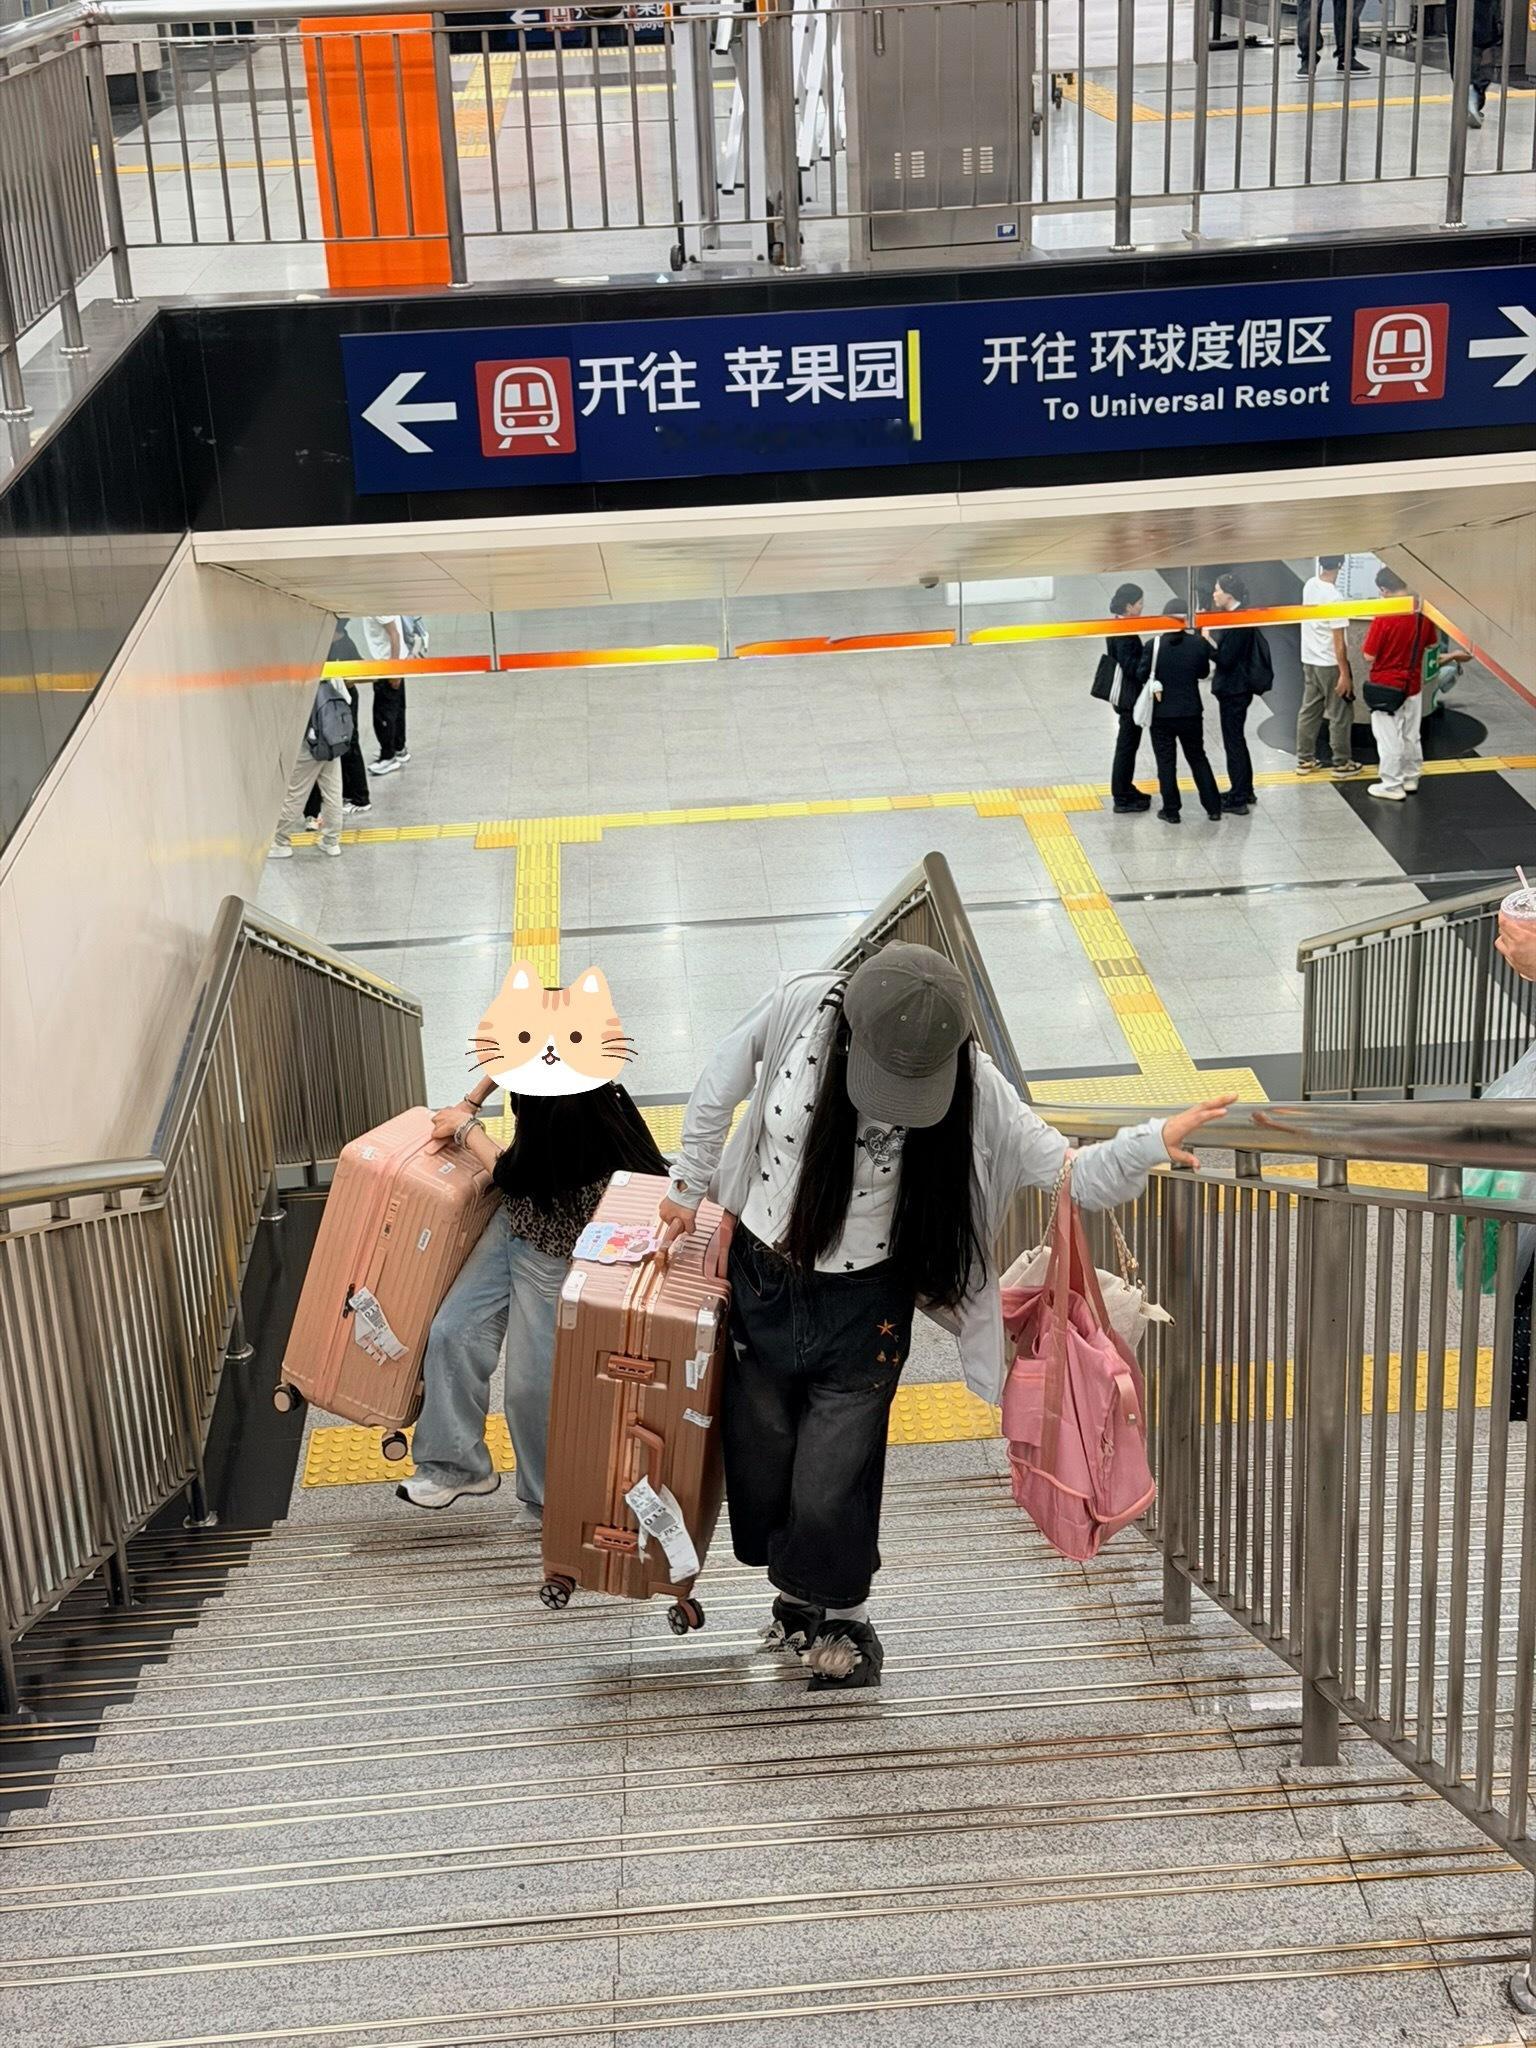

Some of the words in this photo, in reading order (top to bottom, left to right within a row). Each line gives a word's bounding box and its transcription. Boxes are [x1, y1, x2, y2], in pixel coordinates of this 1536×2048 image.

[578, 350, 701, 417] 开往
[724, 340, 904, 408] 苹果园
[982, 331, 1078, 385] 开往
[1090, 315, 1333, 377] 环球度假区
[1043, 397, 1079, 421] To
[1090, 387, 1224, 418] Universal
[1235, 381, 1330, 409] Resort
